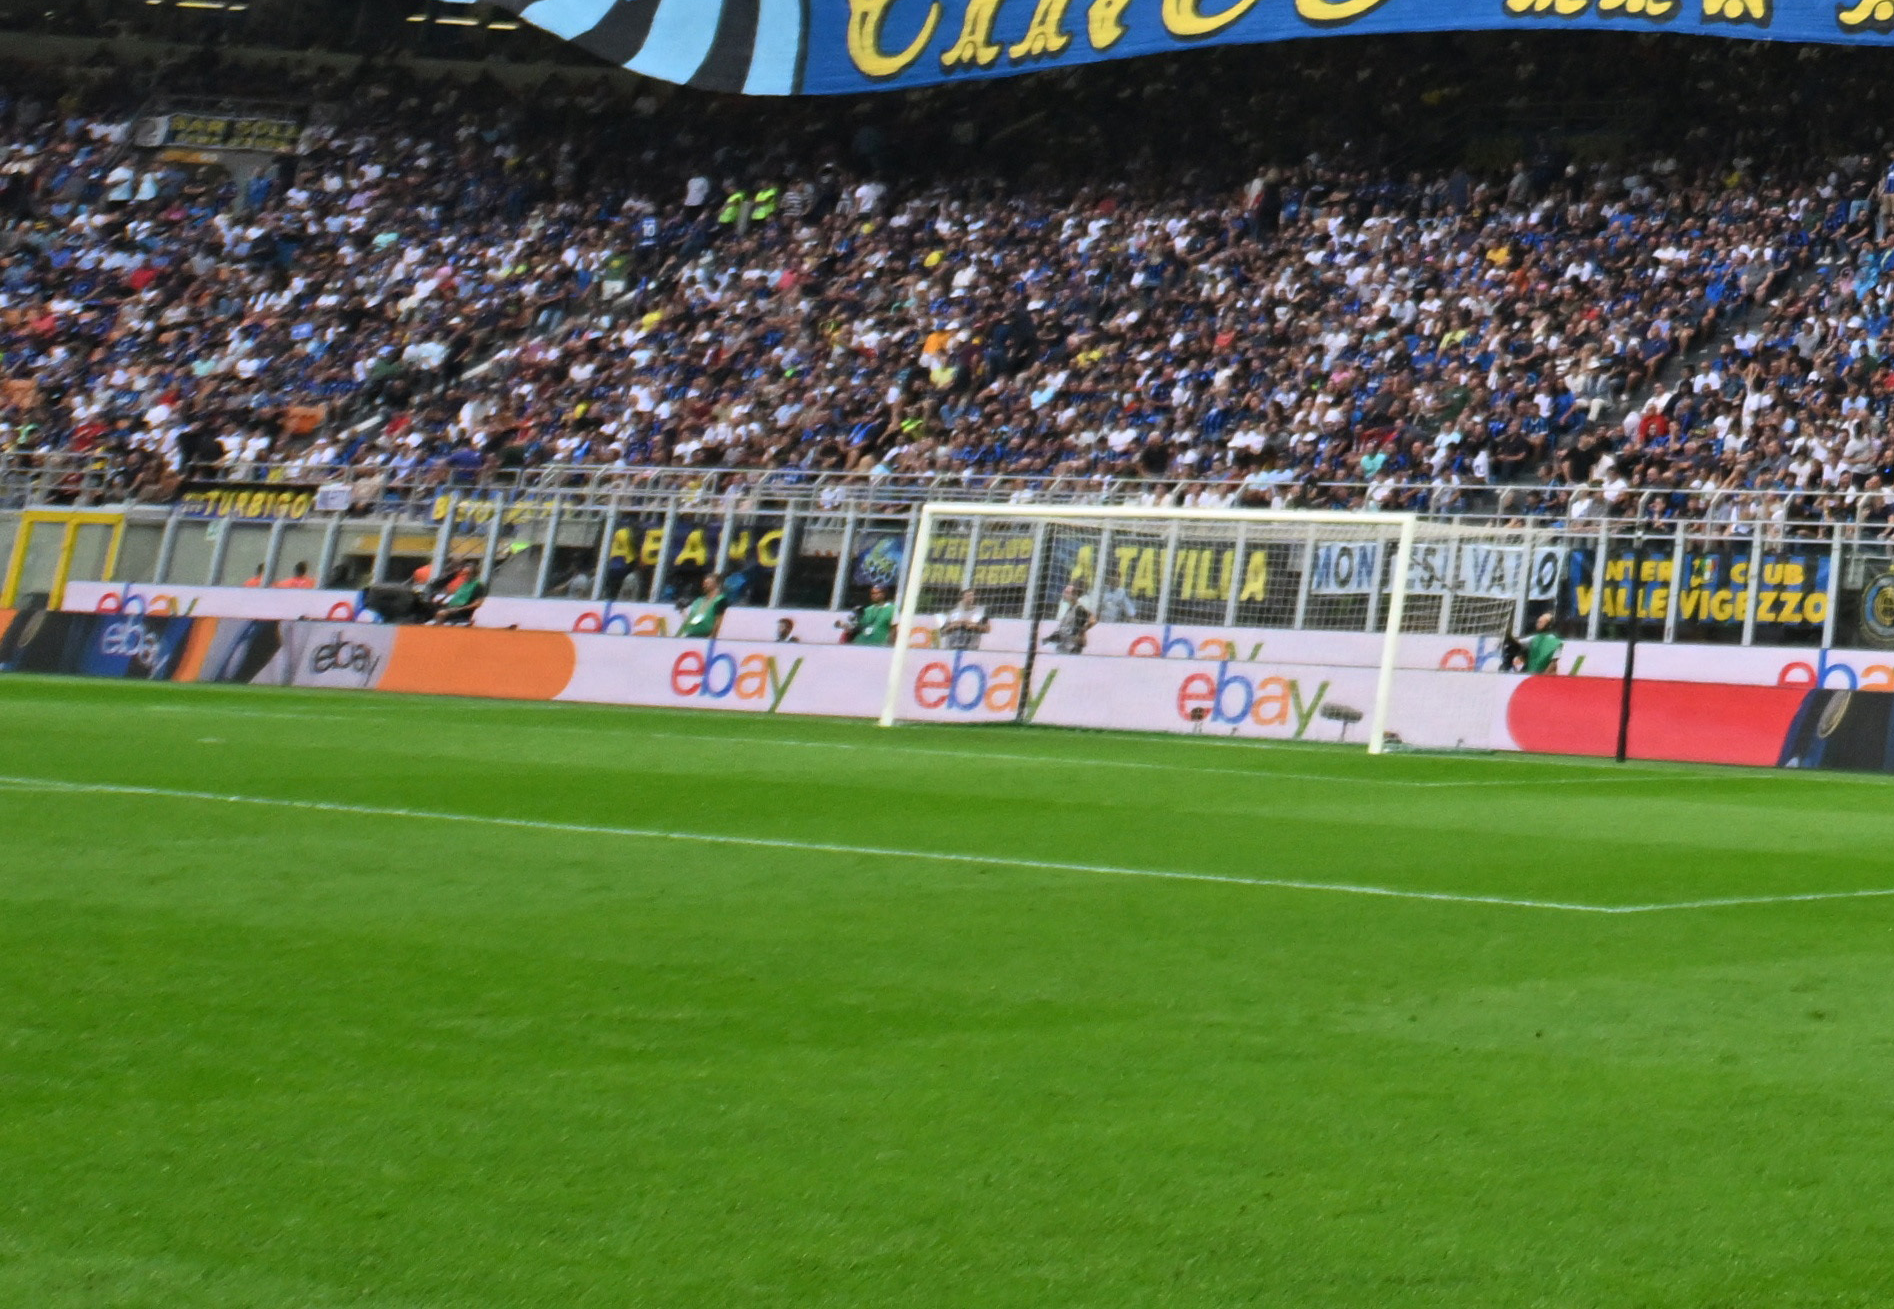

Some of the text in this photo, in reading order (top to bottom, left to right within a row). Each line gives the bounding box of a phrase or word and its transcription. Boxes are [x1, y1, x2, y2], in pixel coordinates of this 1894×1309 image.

[203, 489, 311, 519] TURBIGO
[1071, 545, 1267, 602] ATAVILLA
[1313, 543, 1559, 596] MONESILVAO
[1606, 558, 1675, 584] NTER
[1730, 562, 1806, 586] CUB
[1576, 585, 1829, 624] VALLE VIGEZZO
[311, 629, 381, 687] ebay
[671, 638, 803, 713] ebay
[914, 649, 1059, 724] ebay
[1177, 661, 1330, 739] ebay
